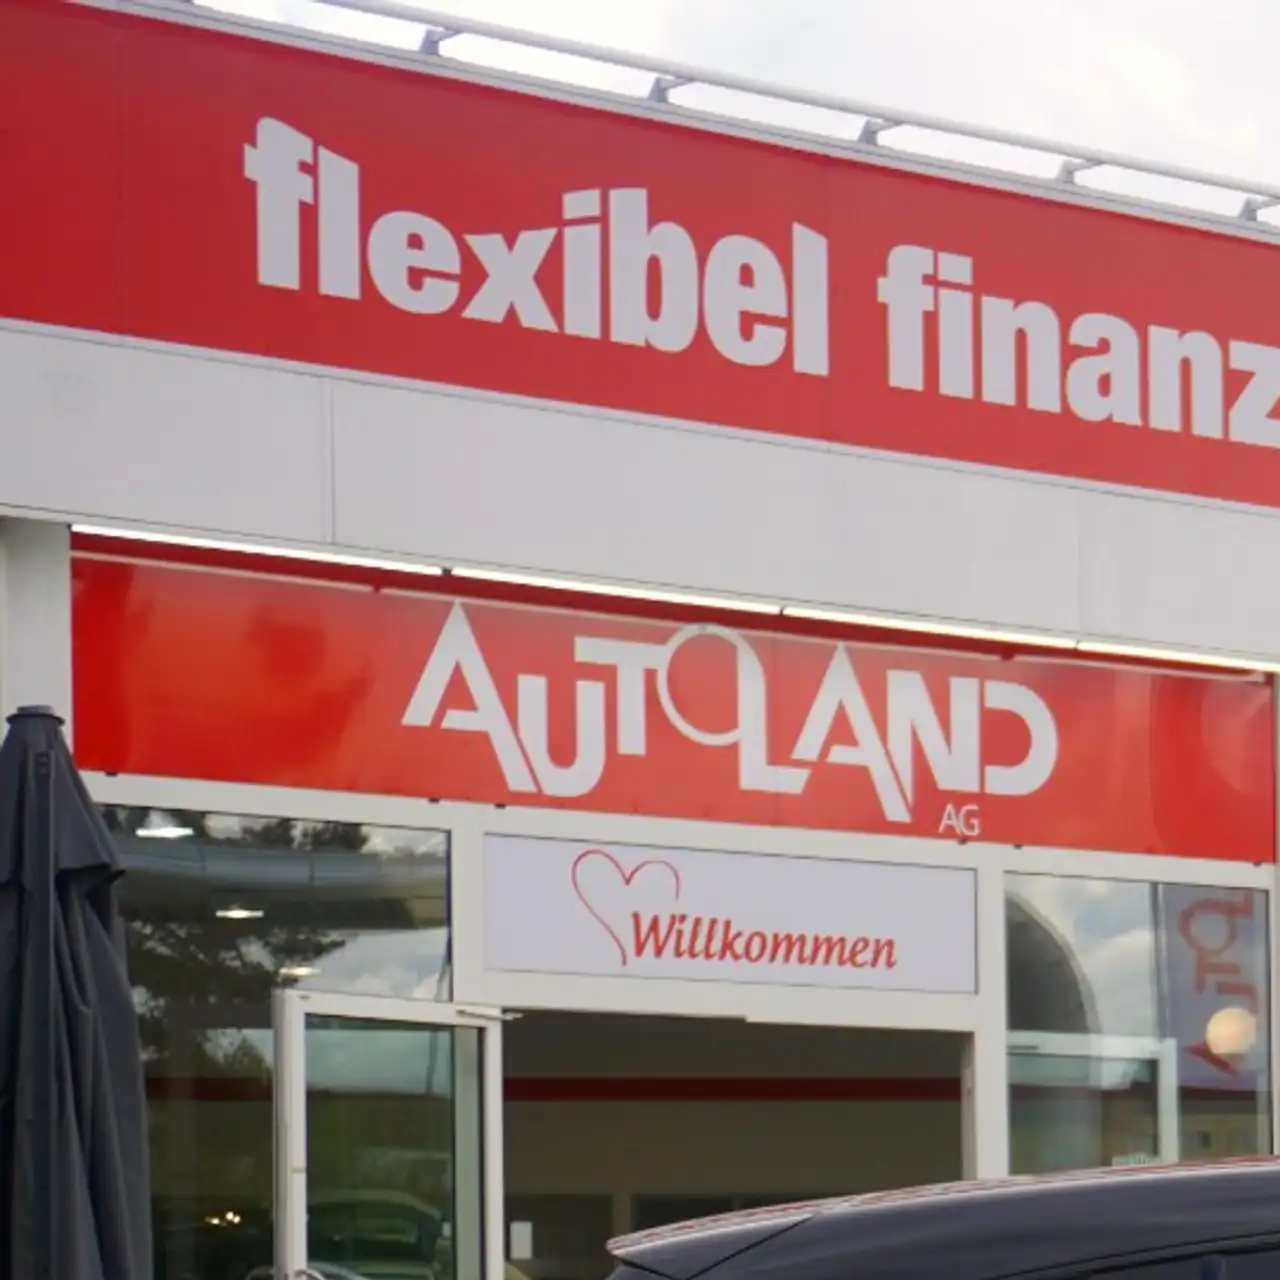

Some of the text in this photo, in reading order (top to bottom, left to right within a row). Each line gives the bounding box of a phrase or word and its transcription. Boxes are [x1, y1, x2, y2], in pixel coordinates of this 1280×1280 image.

[243, 116, 830, 376] flexibel
[401, 599, 1058, 822] AUTOLAND
[938, 803, 980, 836] AG
[630, 910, 897, 969] Willkommen
